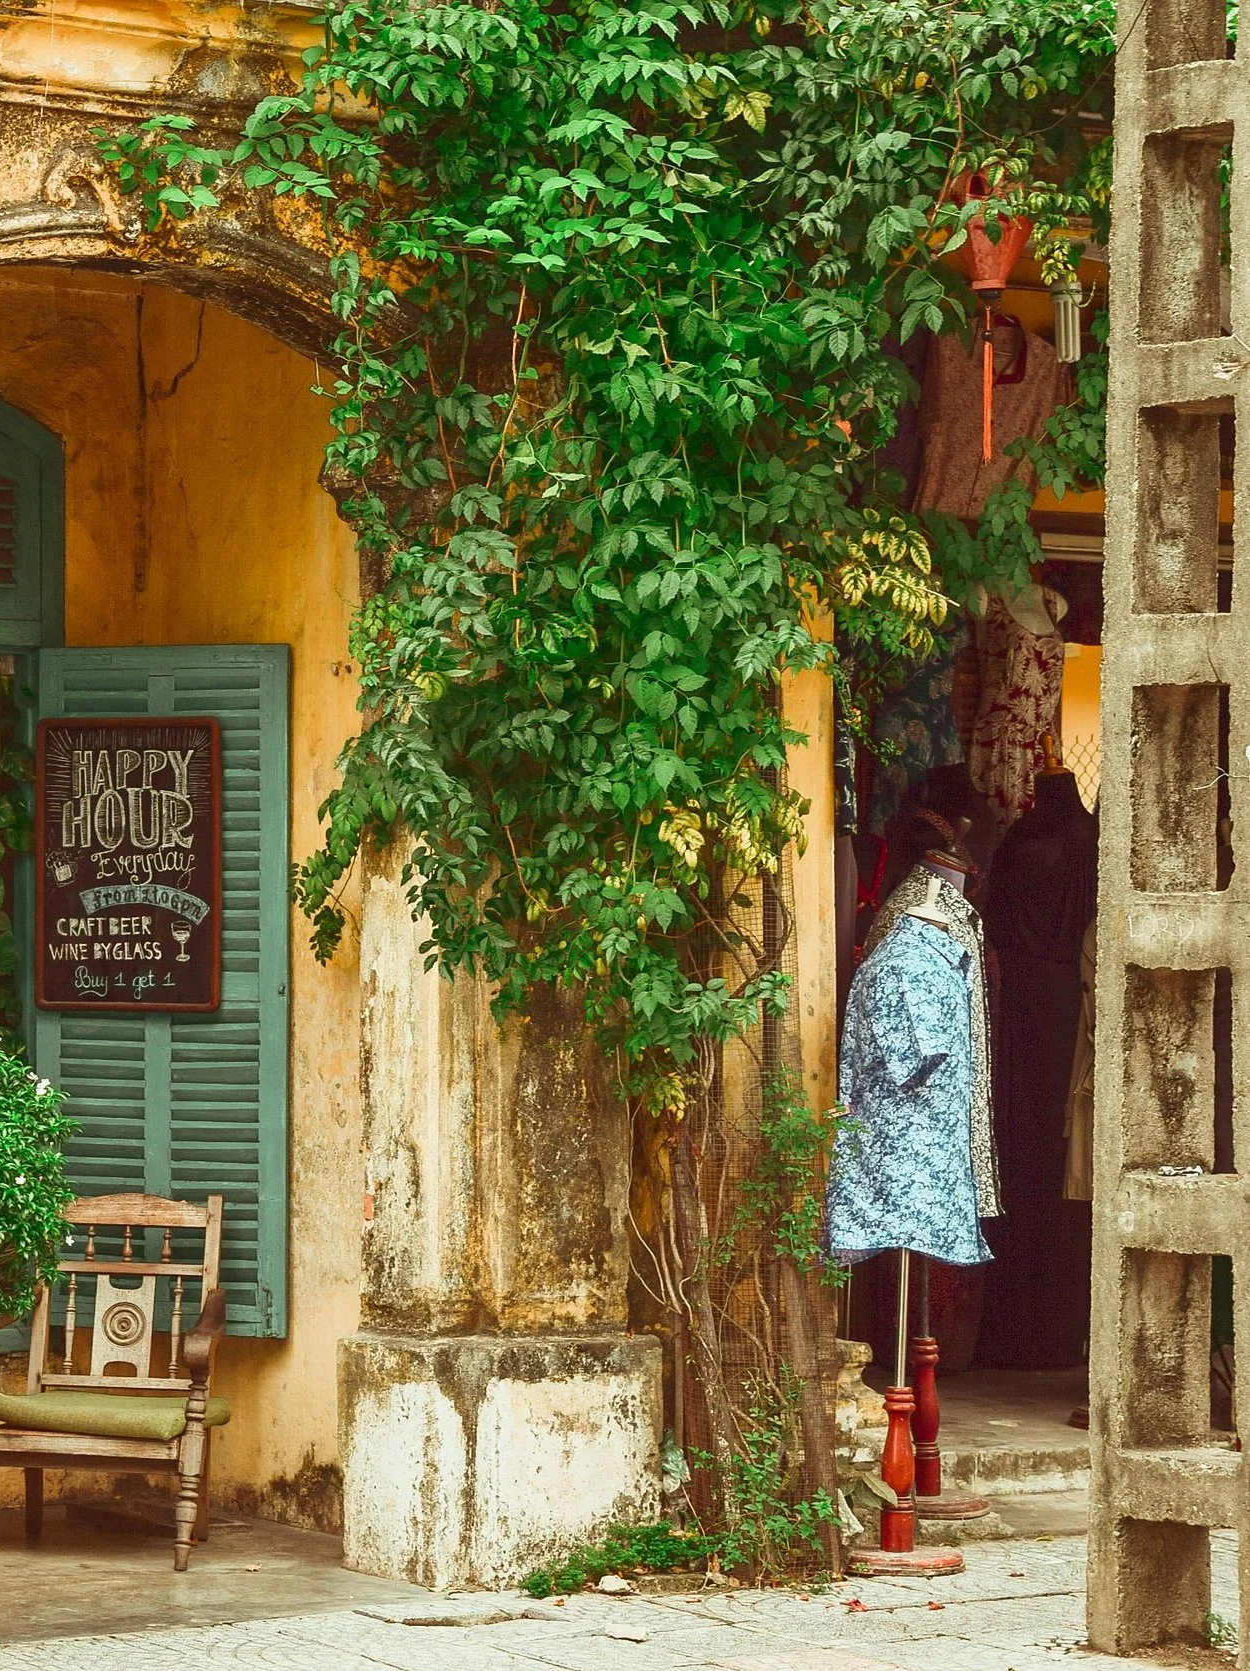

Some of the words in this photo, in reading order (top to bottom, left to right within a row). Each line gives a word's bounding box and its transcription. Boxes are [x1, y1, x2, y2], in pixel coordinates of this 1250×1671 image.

[72, 750, 194, 798] HAPPY
[62, 788, 194, 849] HOUR
[91, 846, 196, 890] Everyday
[92, 888, 139, 910] from
[56, 917, 107, 936] CRAFT
[108, 915, 152, 936] BEER
[48, 942, 89, 960] WINE
[74, 965, 108, 997] Buy
[114, 971, 127, 986] 1
[132, 969, 155, 1000] get
[162, 971, 177, 986] 1
